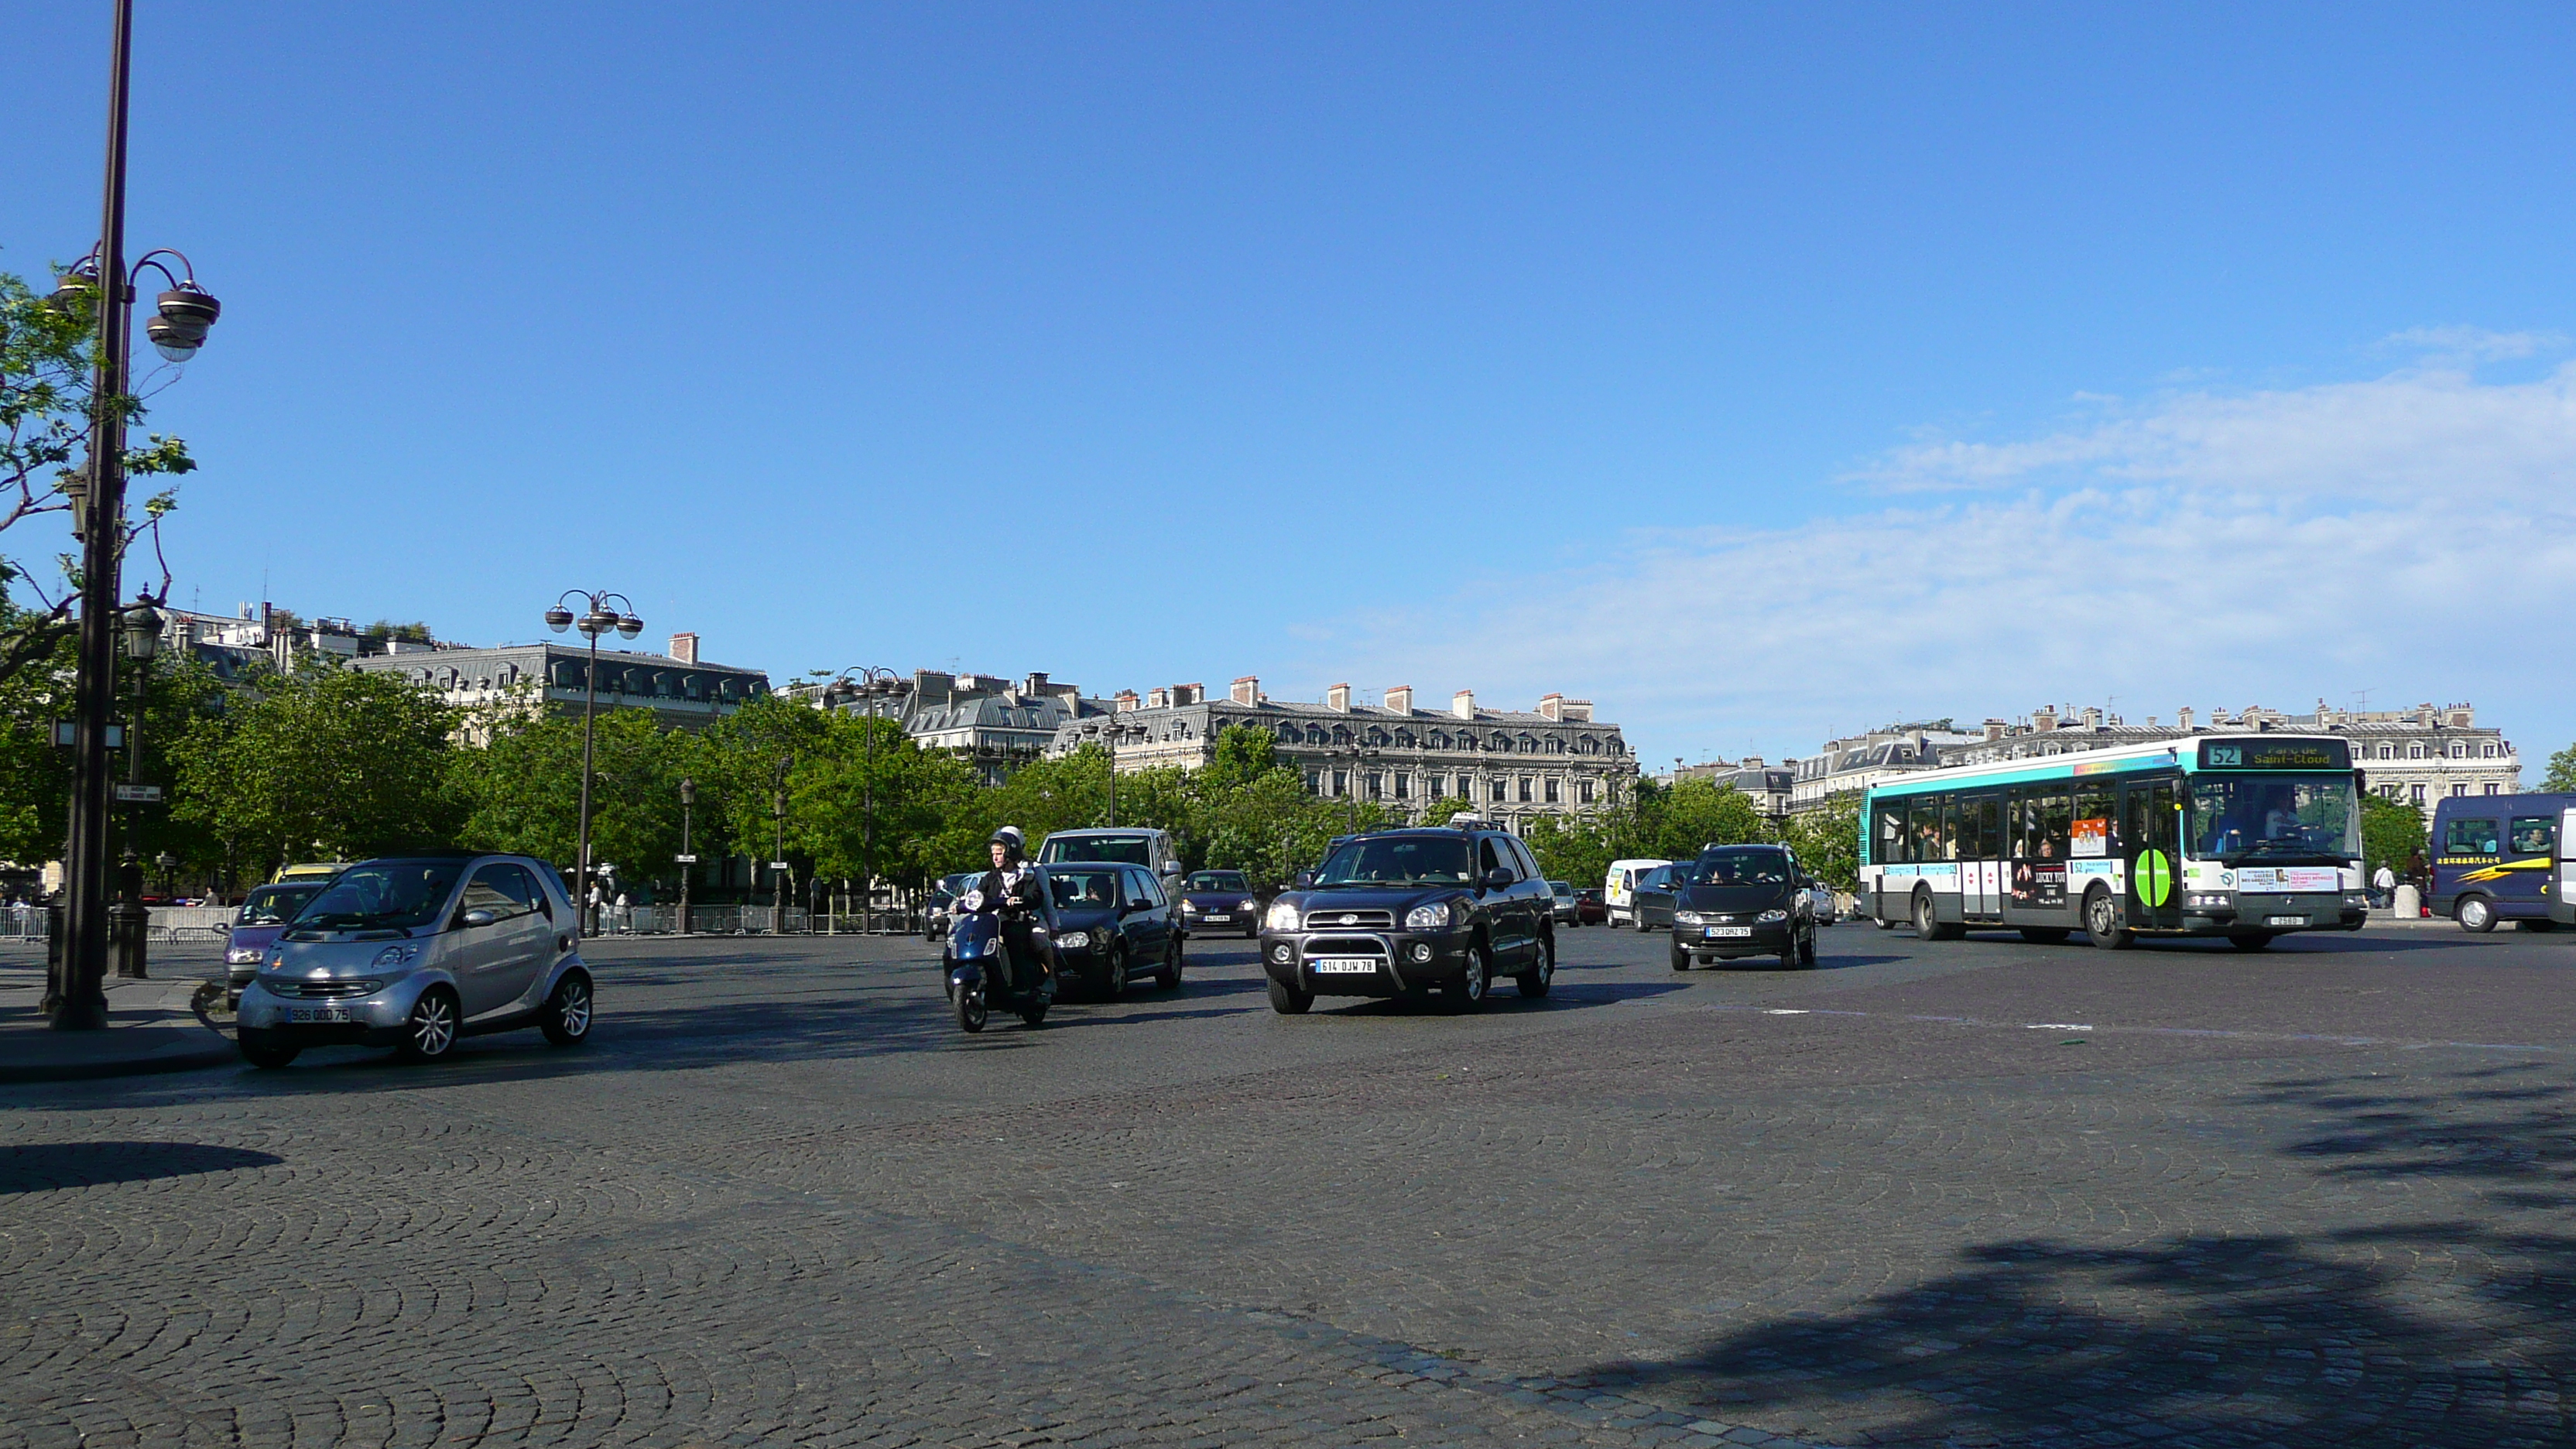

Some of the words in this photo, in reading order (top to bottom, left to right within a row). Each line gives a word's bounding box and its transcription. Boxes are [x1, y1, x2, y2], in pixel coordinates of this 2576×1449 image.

[2214, 747, 2235, 764] 52
[2254, 754, 2331, 764] Saint-Cloud
[2074, 862, 2083, 873] 52
[2035, 872, 2053, 883] LUCKY
[2054, 872, 2066, 883] YOU
[1739, 927, 1749, 936] 75
[1322, 961, 1337, 971] 614
[1341, 961, 1358, 971] DJW
[1362, 961, 1372, 971] 78
[292, 1009, 311, 1020] 926
[335, 1009, 349, 1020] 75
